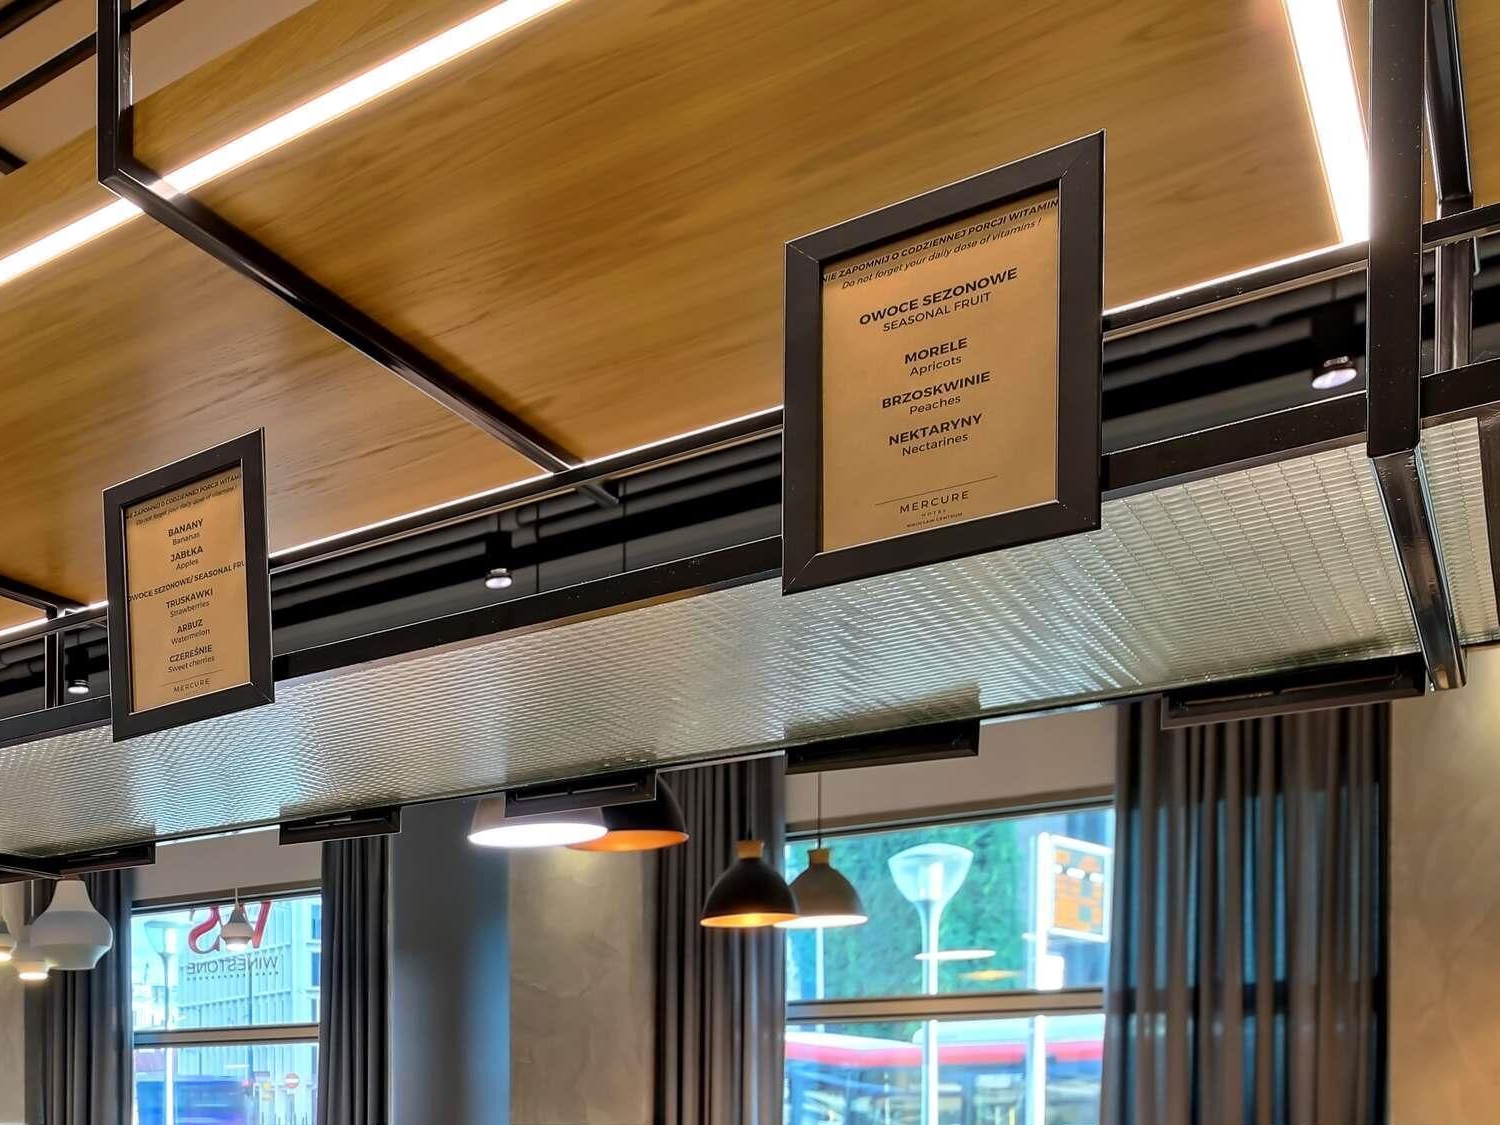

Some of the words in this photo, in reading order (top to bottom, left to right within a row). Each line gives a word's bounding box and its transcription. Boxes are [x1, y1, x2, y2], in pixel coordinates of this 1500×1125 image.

[838, 254, 889, 278] ZAPOMNIJ
[892, 251, 899, 260] O
[901, 228, 965, 257] CODZIENNEJ
[967, 215, 1006, 235] PORCJI
[842, 278, 853, 289] Do
[856, 273, 872, 285] not
[874, 262, 902, 280] forget
[905, 256, 926, 270] your
[928, 246, 952, 262] daily
[953, 238, 976, 253] dose
[979, 233, 990, 245] of
[991, 218, 1035, 240] vitamins
[859, 297, 918, 326] OWOCE
[922, 266, 1017, 307] SEZONOWE
[883, 303, 950, 333] SEASONAL
[954, 290, 991, 311] FRUIT
[904, 335, 967, 365] MORELE
[909, 353, 962, 379] Apricots
[882, 369, 990, 410] BRZOSKWINIE
[909, 392, 961, 416] Peaches
[888, 412, 981, 446] NEKTARYNY
[902, 431, 968, 456] Nectarines
[899, 490, 969, 513] MERCURE
[168, 517, 203, 538] BANANY
[172, 529, 200, 545] Bananas
[170, 543, 203, 562] JABŁKA
[176, 556, 198, 571] Apples
[194, 563, 231, 582] SEASONAL
[166, 587, 212, 609] TRUSKAWKI
[169, 598, 209, 618] Strawberries
[172, 627, 210, 645] Watermelon
[176, 618, 202, 633] ARBUZ
[168, 661, 188, 673] Sweet
[188, 653, 214, 667] cherries
[169, 642, 212, 663] CZEREŚNIE
[173, 677, 210, 692] MERCURE
